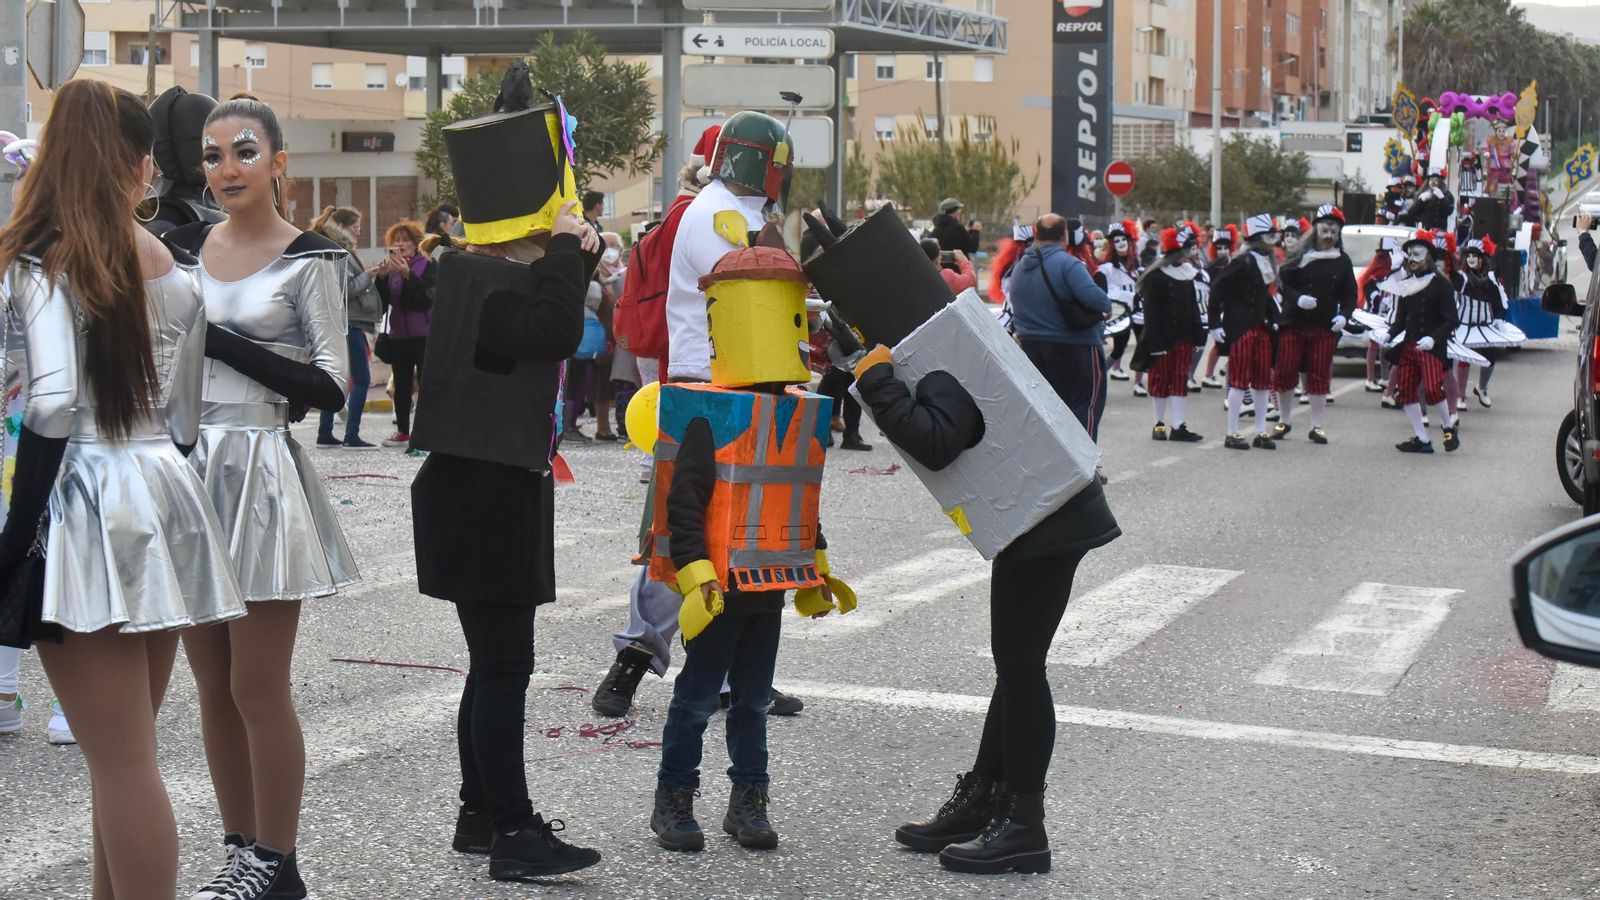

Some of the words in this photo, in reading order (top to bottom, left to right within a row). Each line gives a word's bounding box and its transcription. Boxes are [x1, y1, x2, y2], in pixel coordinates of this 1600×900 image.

[1057, 22, 1103, 32] REPSOL
[745, 36, 787, 47] POLICÍA
[790, 38, 826, 47] LOCAL
[1077, 49, 1098, 202] REPSOL
